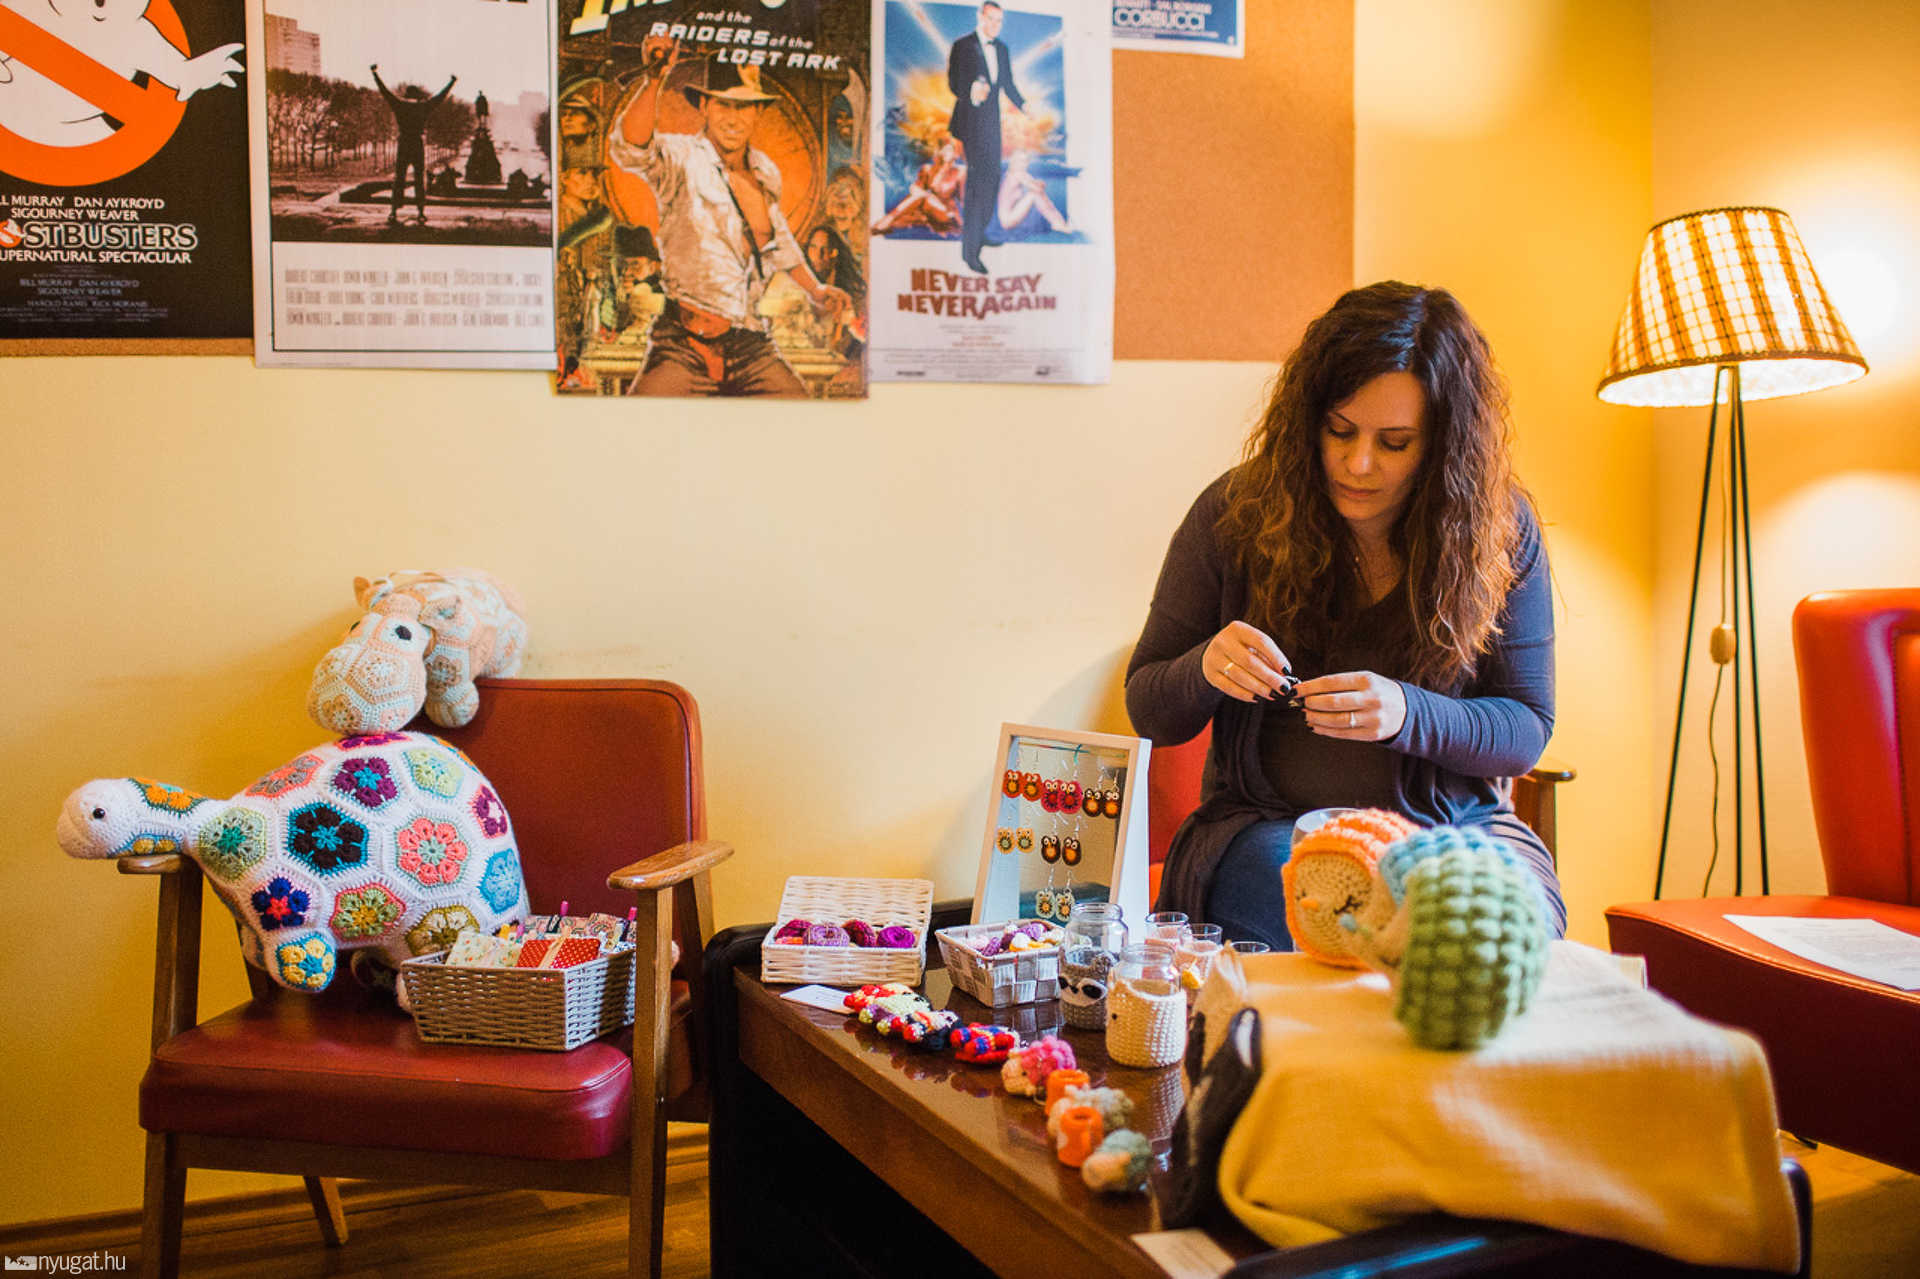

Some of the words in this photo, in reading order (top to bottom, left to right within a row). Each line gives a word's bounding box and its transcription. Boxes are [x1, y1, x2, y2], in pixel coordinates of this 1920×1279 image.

[696, 9, 725, 21] and
[727, 11, 752, 24] the
[649, 22, 770, 46] RAIDERS
[769, 35, 787, 47] of
[788, 36, 814, 49] the
[717, 47, 783, 66] LOST
[787, 52, 841, 71] ARK
[11, 195, 64, 207] MURRAY
[74, 196, 102, 208] DAN
[105, 197, 165, 209] AYKROYD
[11, 207, 83, 219] SIGOURNEY
[86, 209, 139, 221] WEAVER
[99, 251, 192, 264] SPECTACULAR
[910, 268, 990, 294] NEVER
[995, 273, 1043, 294] SAY
[897, 294, 983, 320] NEVER
[981, 294, 1057, 314] AGAIN
